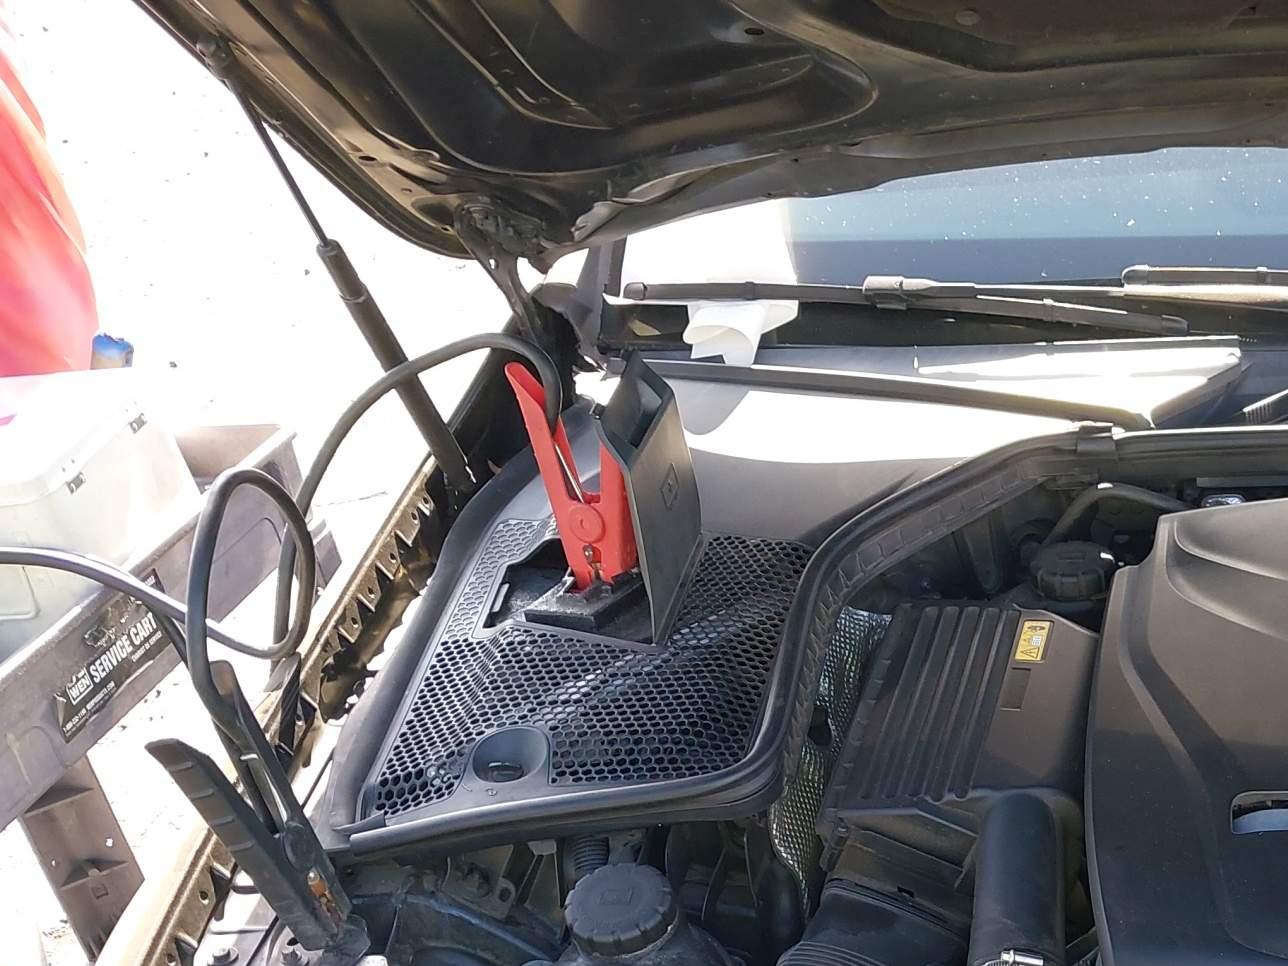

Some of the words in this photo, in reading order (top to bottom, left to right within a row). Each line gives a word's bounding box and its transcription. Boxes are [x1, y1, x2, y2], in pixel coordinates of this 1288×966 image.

[69, 676, 91, 699] WEN
[89, 634, 134, 683] SERVICE
[129, 611, 158, 645] CART
